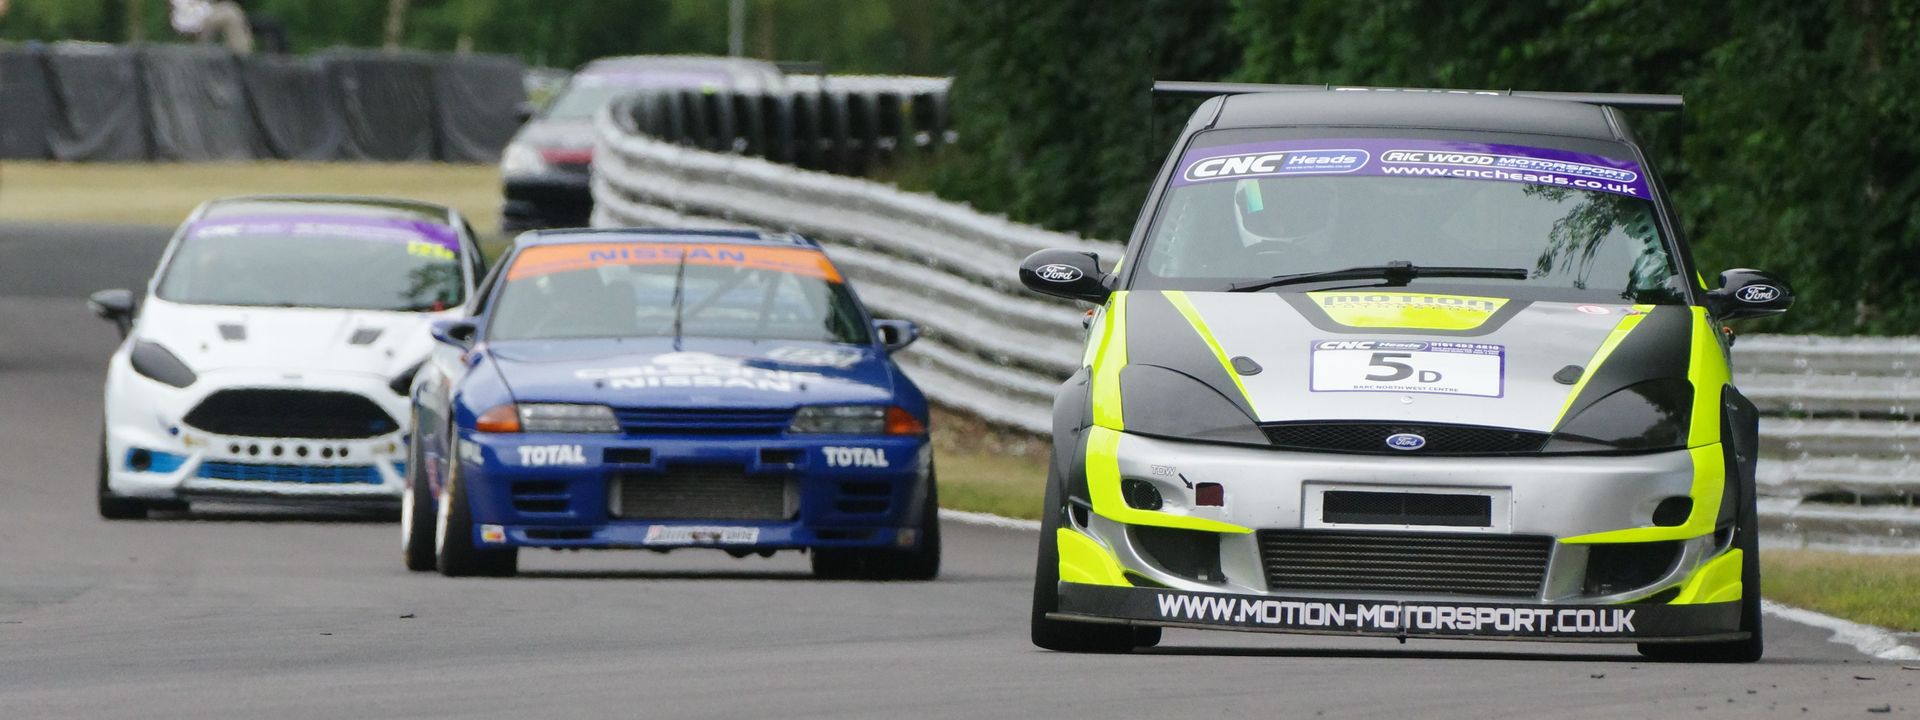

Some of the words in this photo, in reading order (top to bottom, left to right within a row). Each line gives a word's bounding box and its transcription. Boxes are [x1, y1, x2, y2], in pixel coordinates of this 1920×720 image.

[1194, 155, 1283, 177] CNC
[1289, 155, 1357, 165] Heads
[1387, 152, 1424, 162] RIC
[1428, 153, 1494, 165] WOOD
[1498, 157, 1630, 177] MOTORSPORT
[1381, 166, 1637, 195] www.cncheads.co.uk
[589, 247, 745, 262] NISSAN
[1043, 265, 1073, 280] Ford
[1744, 287, 1773, 300] Ford
[1320, 341, 1376, 350] CNC
[1365, 352, 1414, 382] 5
[611, 375, 791, 392] NISSAN
[517, 444, 588, 467] TOTAL
[822, 446, 889, 468] TOTAL
[1151, 464, 1177, 477] TOW
[1157, 593, 1636, 633] WWW.MOTION-MOTORSPORT.CO.UK
